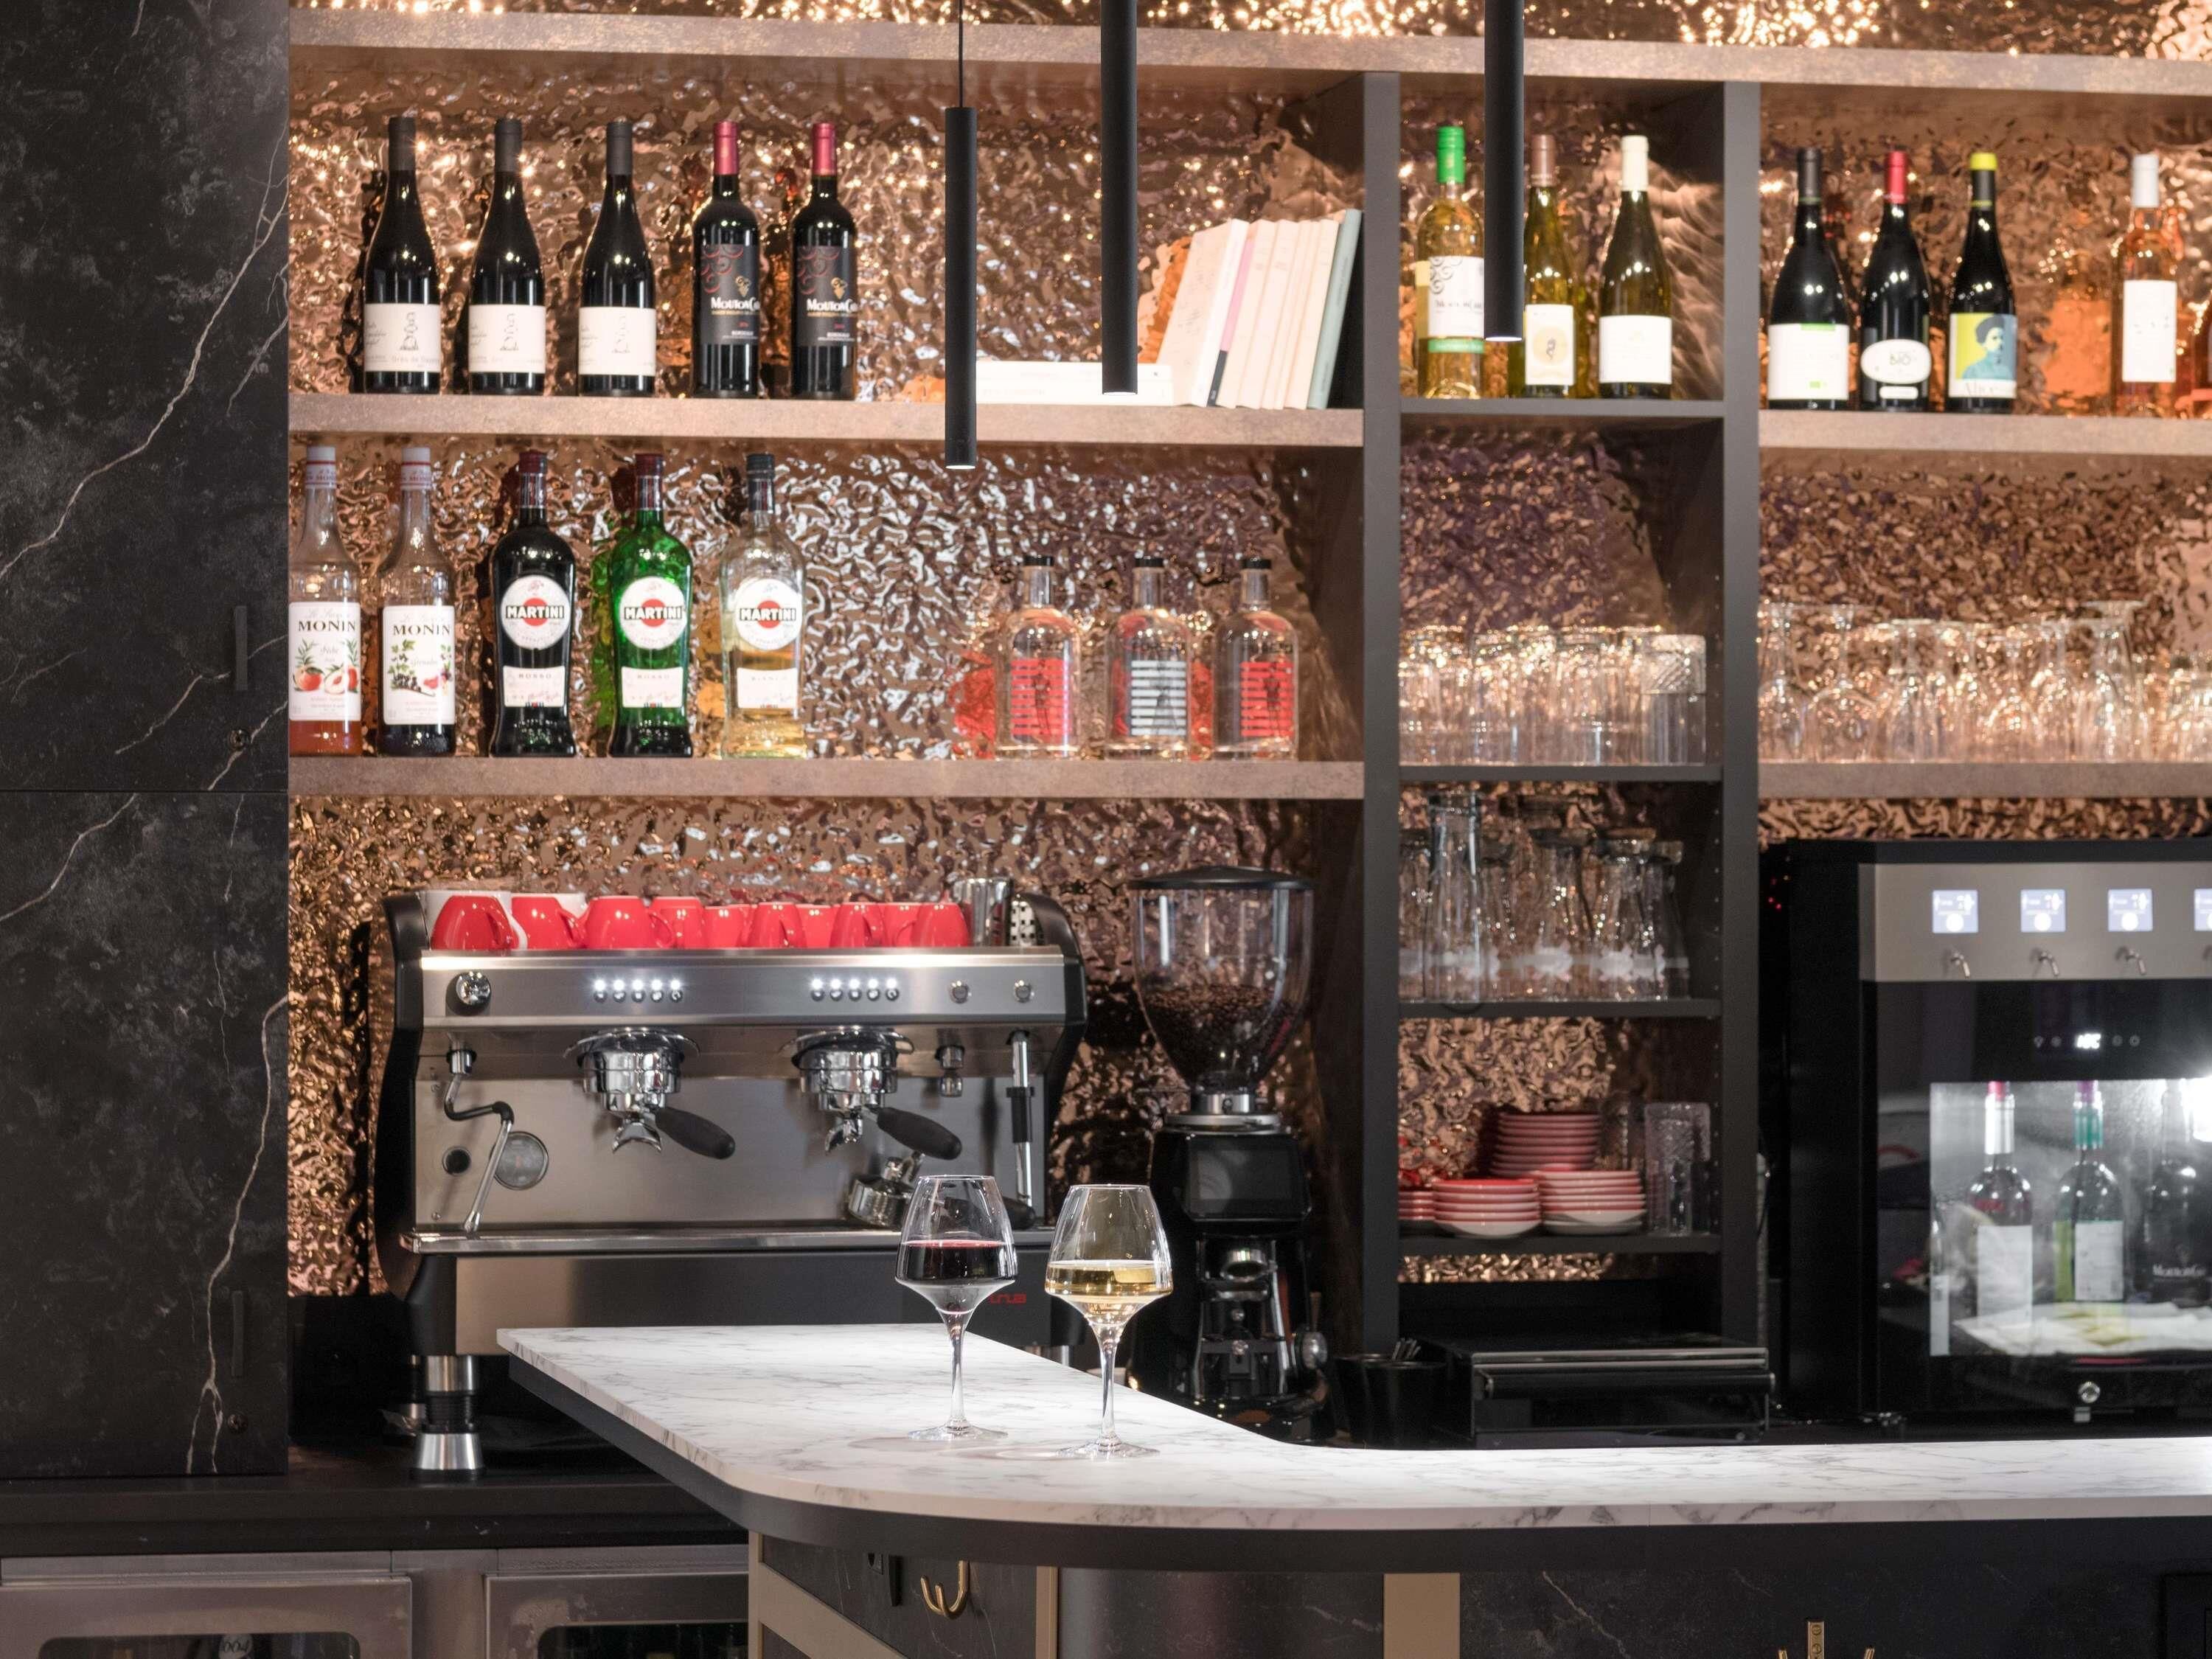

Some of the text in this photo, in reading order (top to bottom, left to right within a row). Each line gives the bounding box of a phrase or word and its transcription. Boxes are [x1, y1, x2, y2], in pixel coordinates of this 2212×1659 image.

[506, 605, 564, 619] MARTINI
[624, 606, 682, 620] MARTINI
[740, 608, 796, 621] MARTINI
[299, 621, 355, 632] MONIN
[393, 625, 451, 636] MONIN
